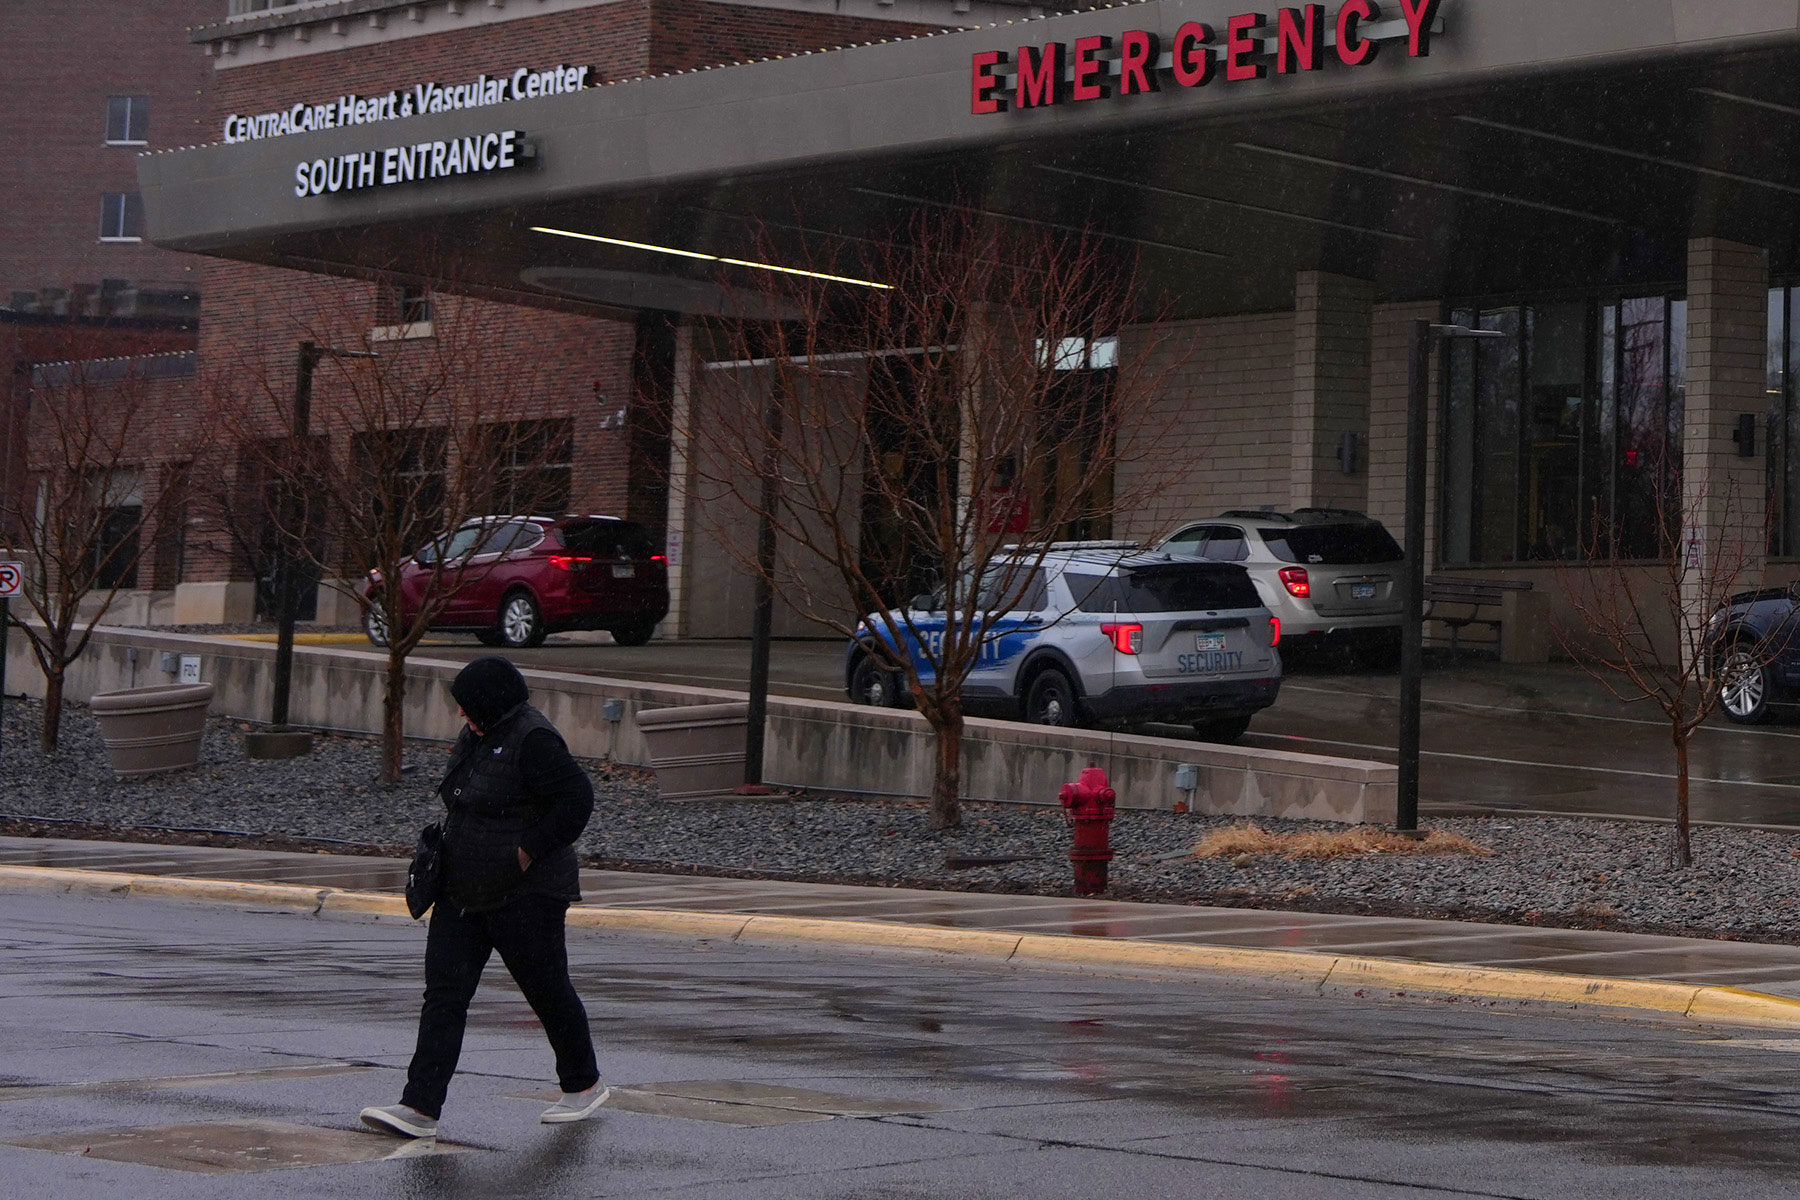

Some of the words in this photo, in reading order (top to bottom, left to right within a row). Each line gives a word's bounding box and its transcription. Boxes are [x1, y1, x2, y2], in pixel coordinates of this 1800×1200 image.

[336, 90, 398, 128] Heart
[400, 92, 413, 119] &
[416, 73, 508, 116] Vascular
[511, 63, 588, 101] Center
[294, 150, 377, 198] SOUTH
[382, 129, 516, 185] ENTRANCE
[1177, 650, 1243, 674] SECURITY
